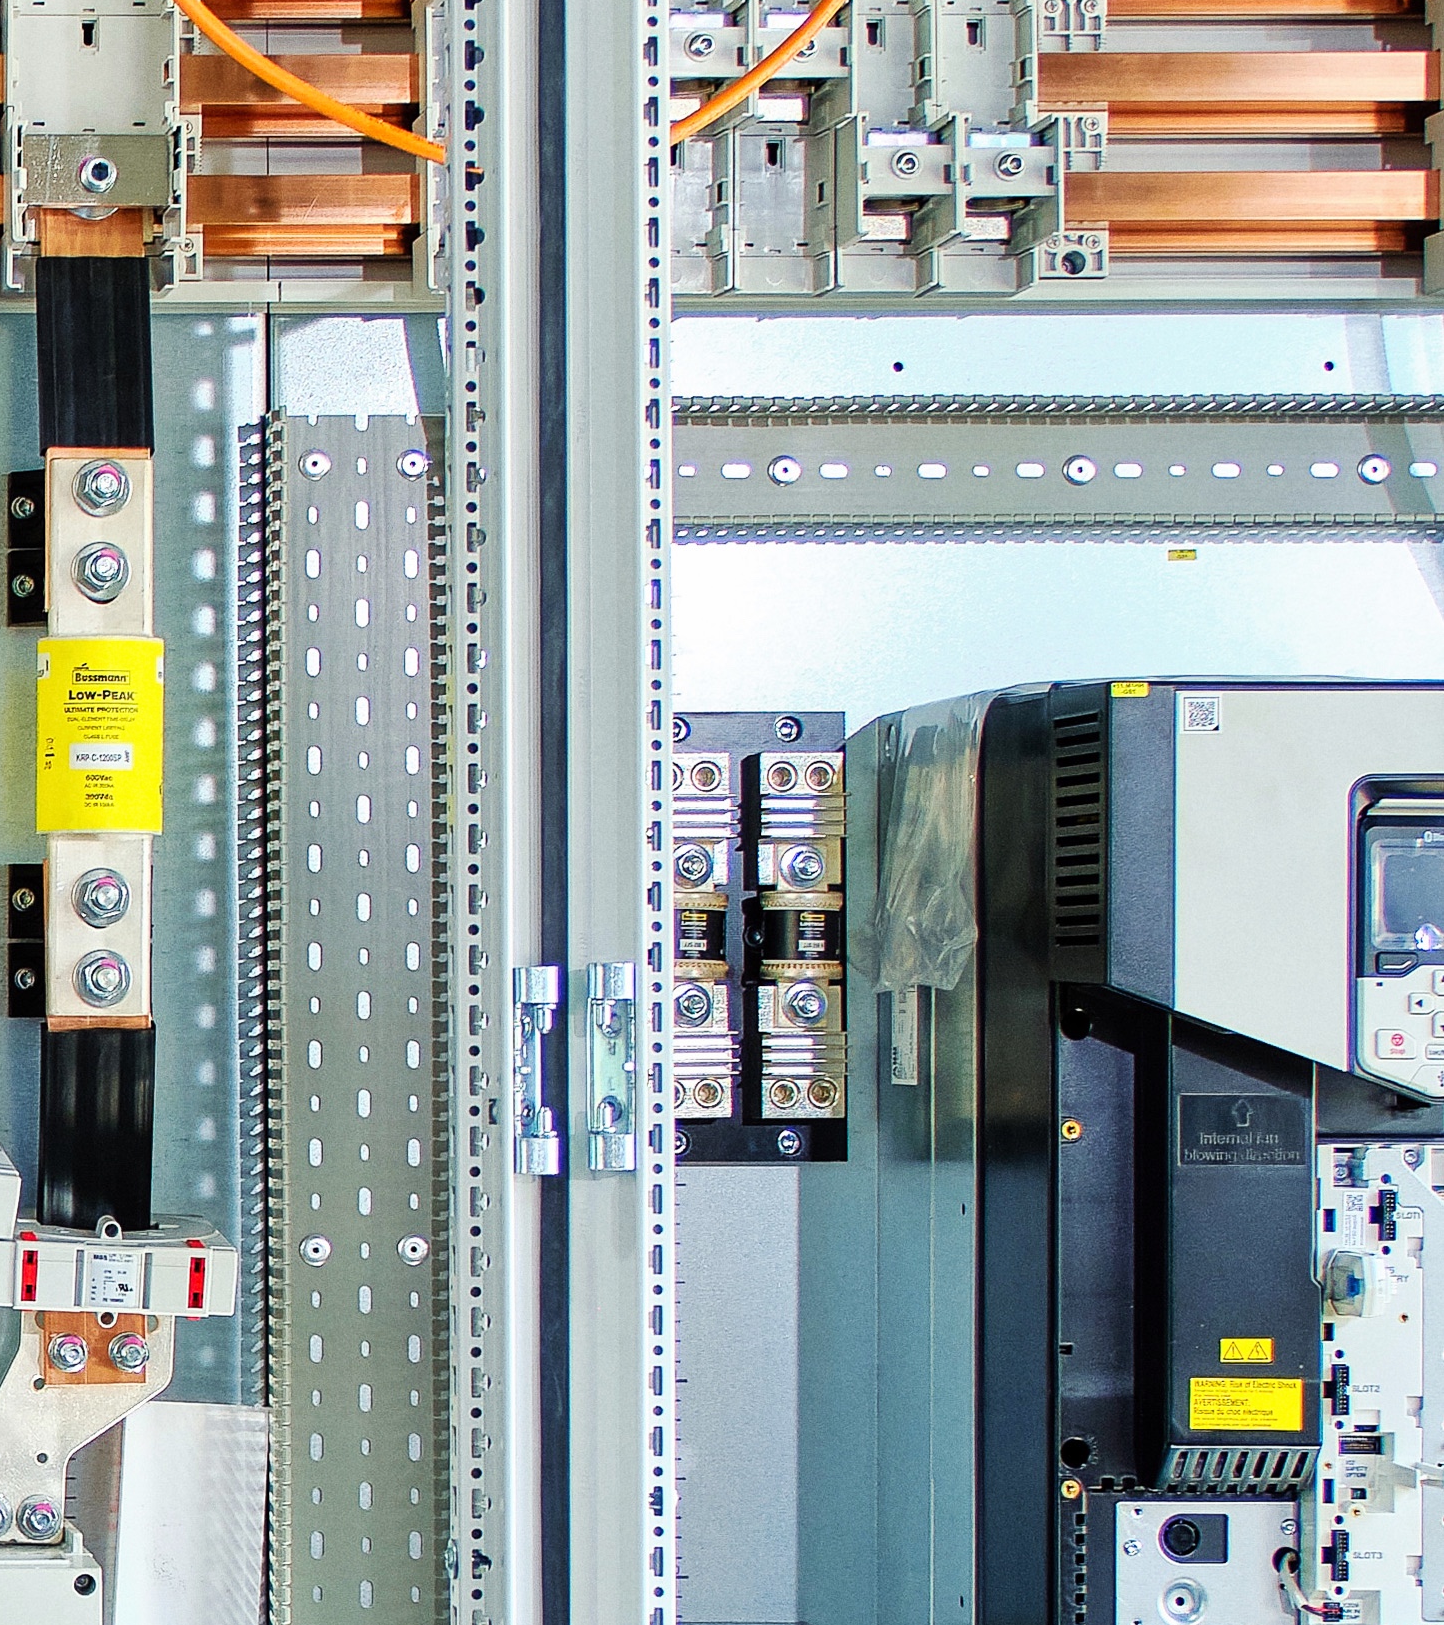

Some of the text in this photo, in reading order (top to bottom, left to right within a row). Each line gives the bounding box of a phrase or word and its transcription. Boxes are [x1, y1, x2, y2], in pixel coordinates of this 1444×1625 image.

[75, 673, 127, 683] Bussmann
[1199, 1132, 1279, 1145] Internal fan
[1184, 1148, 1237, 1162] blowing
[1277, 1381, 1297, 1389] Shock
[1352, 1385, 1381, 1393] SLOT2
[1352, 1552, 1383, 1560] SLOT3
